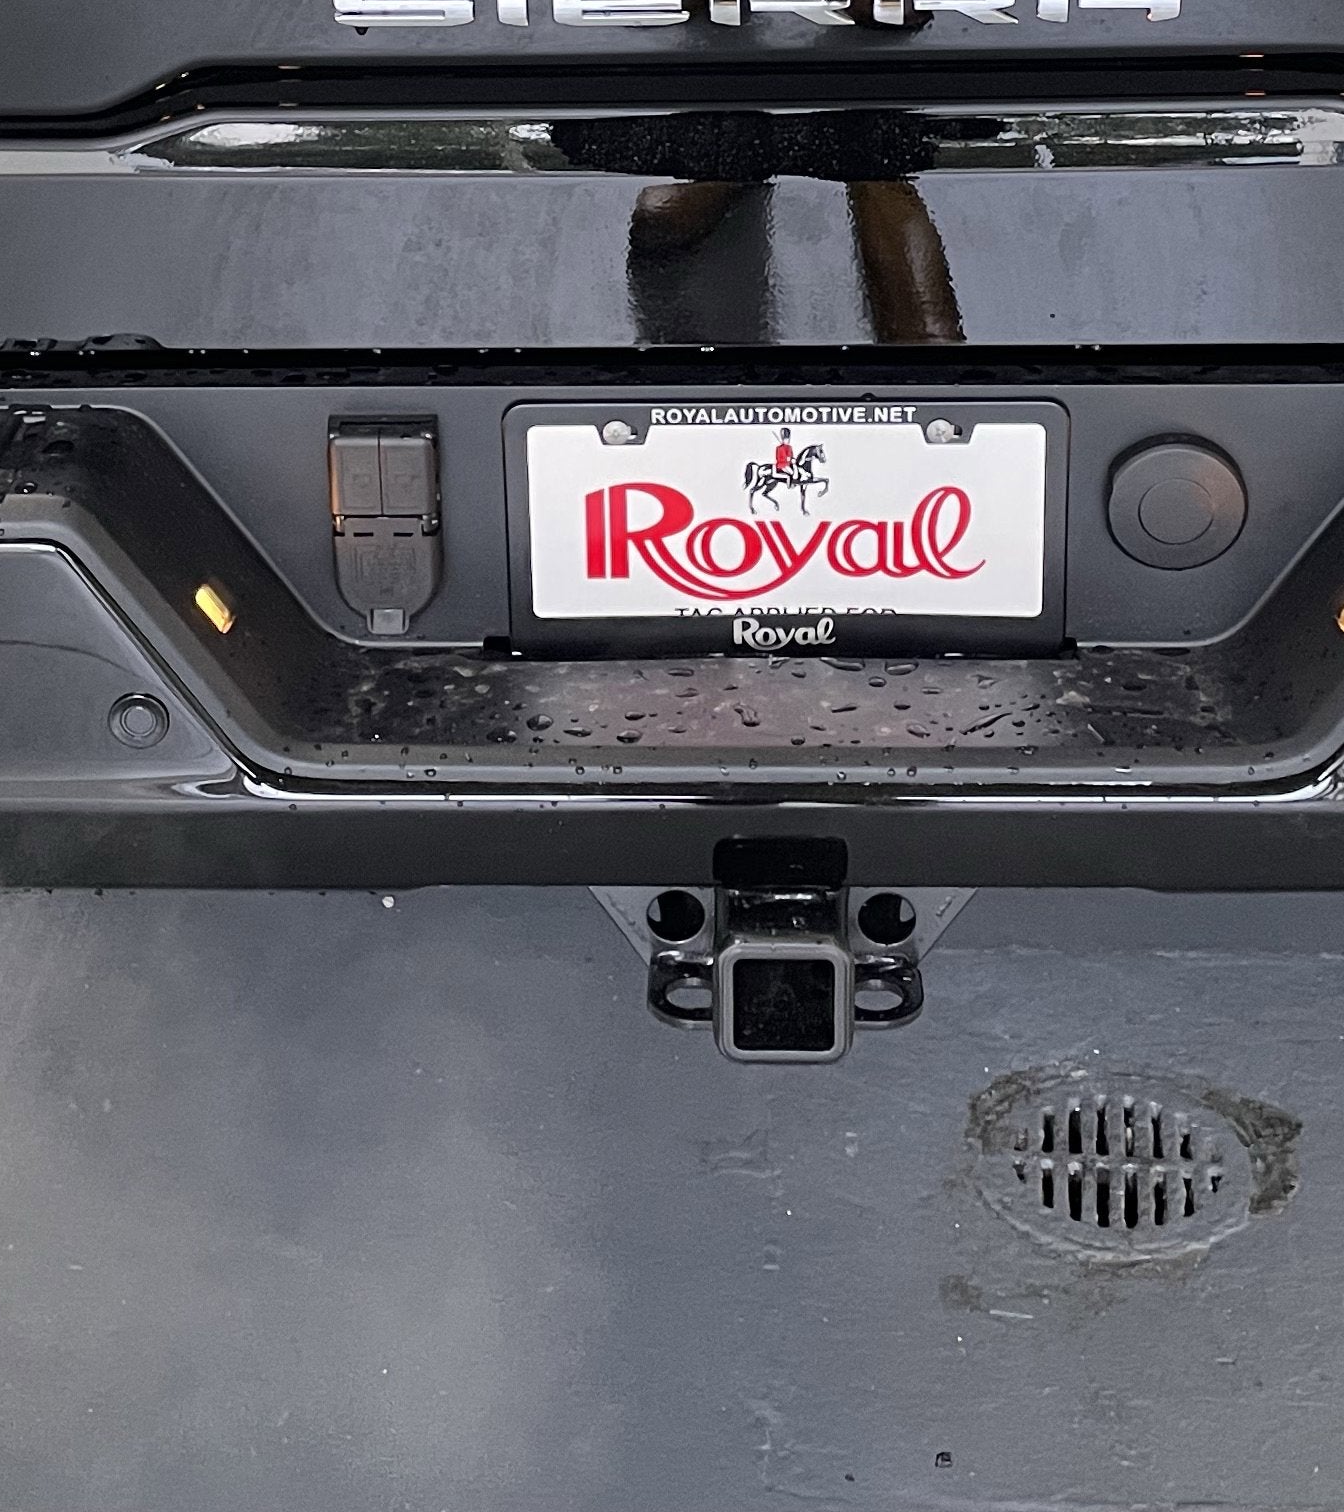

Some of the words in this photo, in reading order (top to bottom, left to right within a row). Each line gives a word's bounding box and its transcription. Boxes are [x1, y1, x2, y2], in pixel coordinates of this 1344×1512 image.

[651, 407, 917, 425] ROYALAUTOMOTIVE.NET
[585, 482, 987, 601] Royal
[733, 617, 837, 651] Royal
